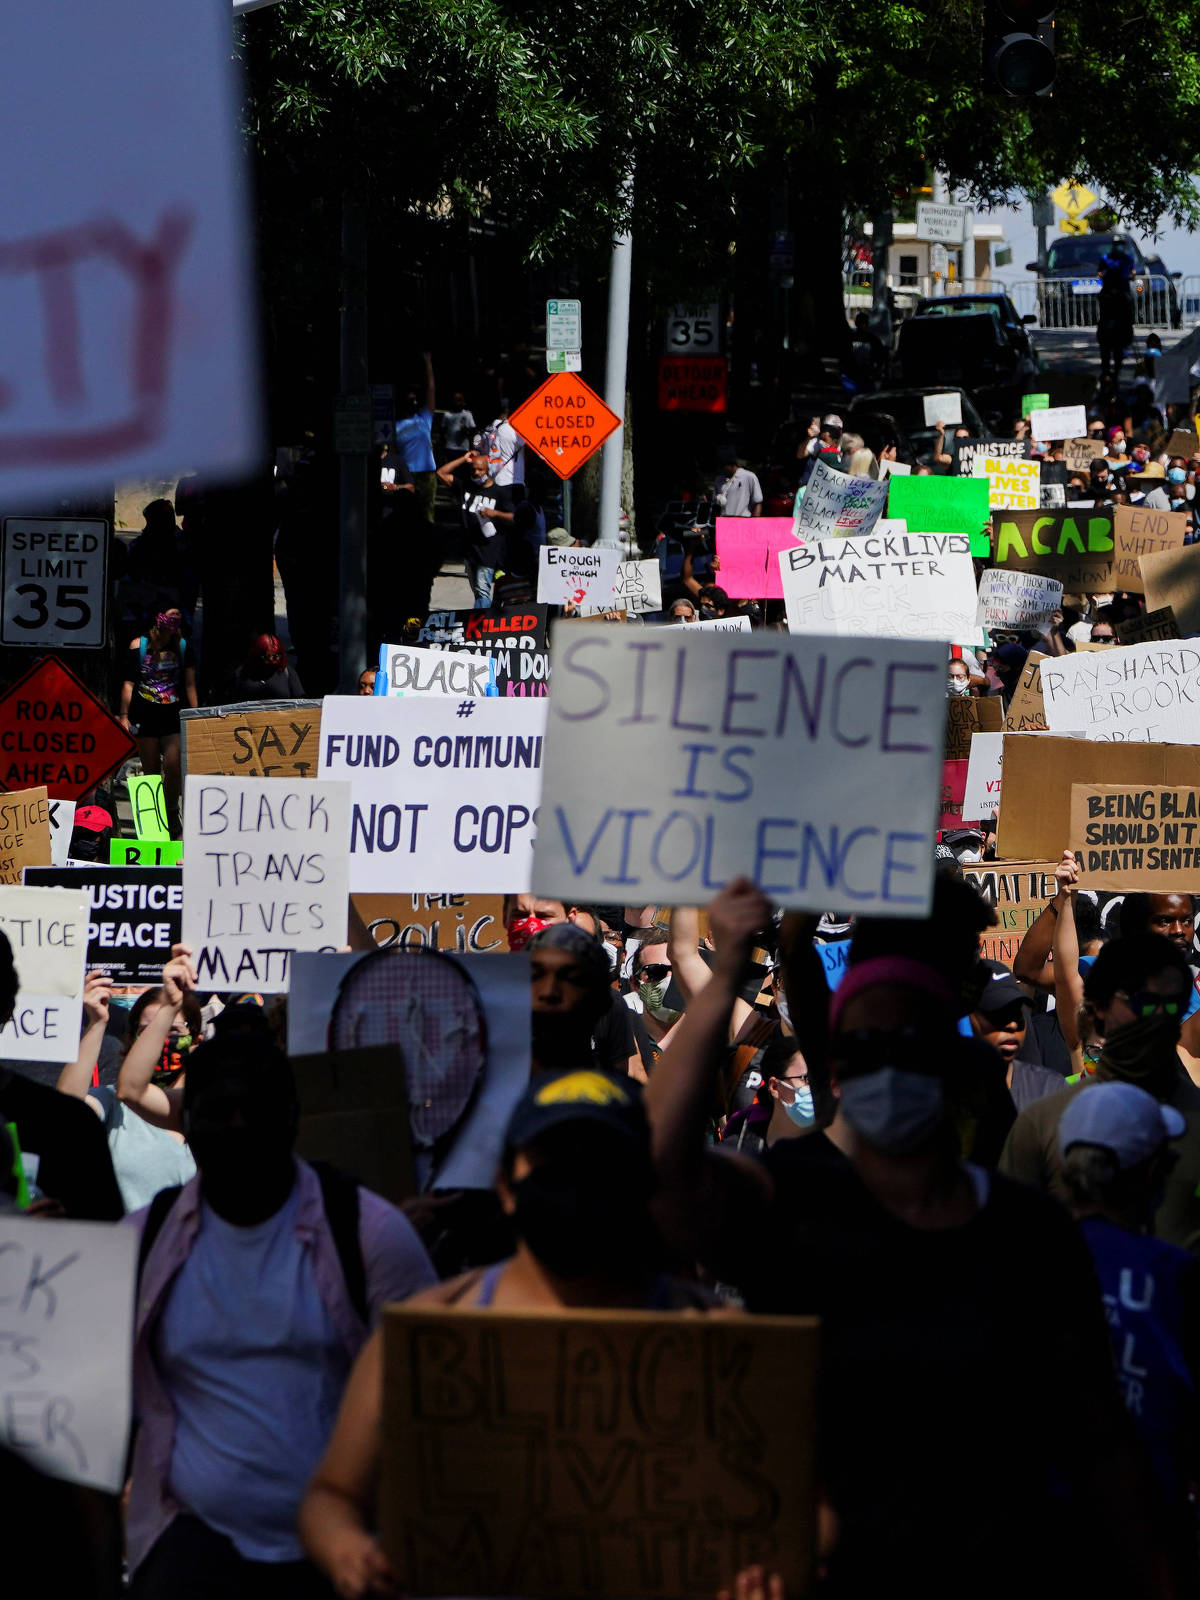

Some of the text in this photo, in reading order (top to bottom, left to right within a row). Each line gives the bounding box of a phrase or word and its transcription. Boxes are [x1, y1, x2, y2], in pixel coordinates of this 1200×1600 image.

[671, 321, 713, 346] 35
[544, 396, 586, 409] ROAD
[535, 416, 595, 429] CLOSED
[539, 435, 592, 449] AHEAD
[985, 459, 1039, 476] BLACK
[988, 478, 1030, 493] LIVES
[1130, 511, 1169, 536] END
[12, 532, 98, 553] SPEED
[789, 534, 970, 572] BLACK LIVES
[996, 517, 1114, 562] ACAB
[20, 559, 87, 579] LIMIT
[547, 548, 601, 568] ENOUGH
[819, 560, 945, 588] MATTER
[11, 584, 92, 630] 35
[465, 613, 538, 639] KILLED
[391, 653, 490, 696] BLACK
[550, 636, 940, 755] SILENCE
[16, 701, 83, 721] ROAD
[1, 732, 96, 753] CLOSED
[232, 721, 312, 766] SAY
[326, 735, 543, 769] FUND COMMUNI
[6, 764, 89, 785] AHEAD
[671, 743, 757, 802] IS
[199, 786, 330, 836] BLACK
[1087, 790, 1156, 820] BEING
[350, 804, 428, 853] NOT
[552, 804, 930, 904] VIOLENCE
[1075, 850, 1086, 873] A
[1088, 849, 1143, 872] DEATH
[205, 852, 326, 888] TRANS
[207, 899, 324, 938] LIVES
[409, 1325, 766, 1441] BLACK
